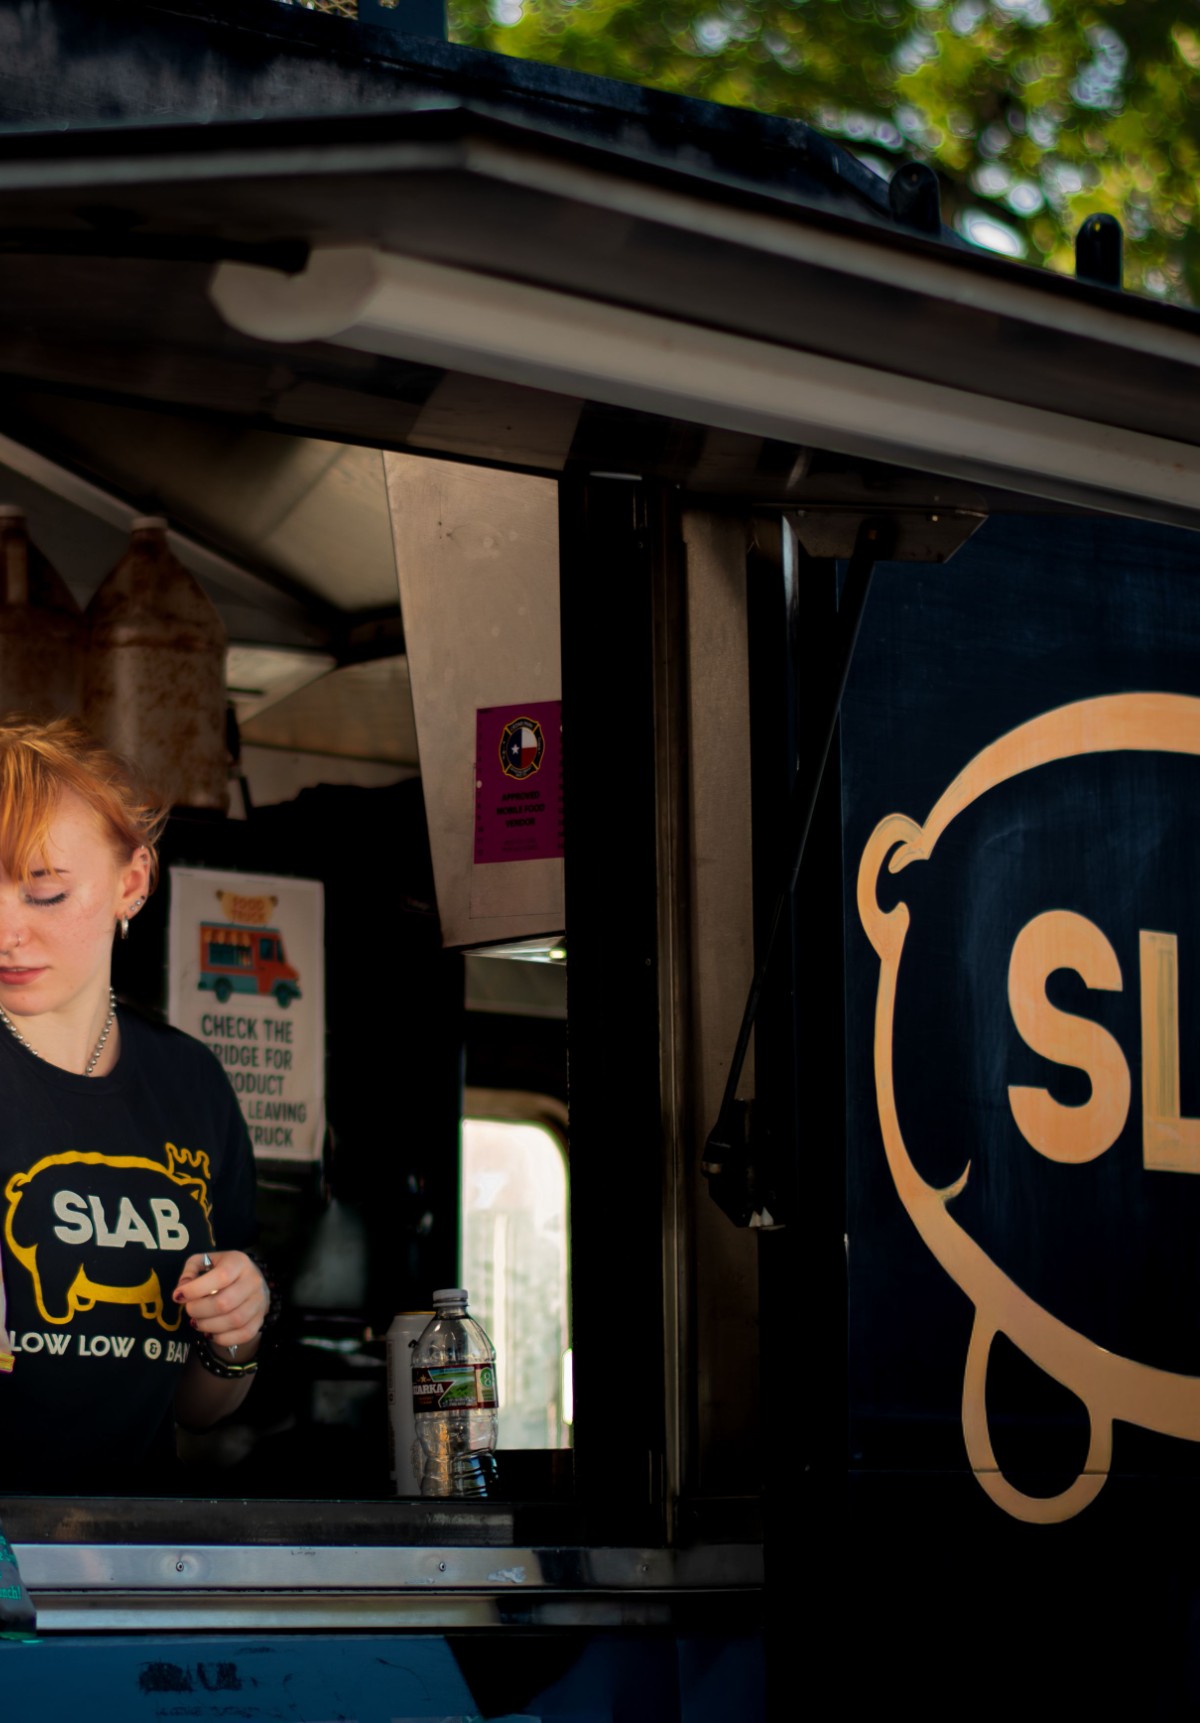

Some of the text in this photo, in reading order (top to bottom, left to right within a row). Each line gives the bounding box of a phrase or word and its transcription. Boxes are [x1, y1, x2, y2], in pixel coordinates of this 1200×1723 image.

[201, 1014, 294, 1043] CHECK THE
[1008, 909, 1200, 1173] SL
[208, 1043, 292, 1070] RIDGE FOR
[248, 1100, 307, 1124] LEAVING
[53, 1189, 190, 1250] SLAB
[9, 1330, 71, 1355] LOW
[78, 1334, 135, 1358] LOW
[166, 1340, 191, 1364] BAN
